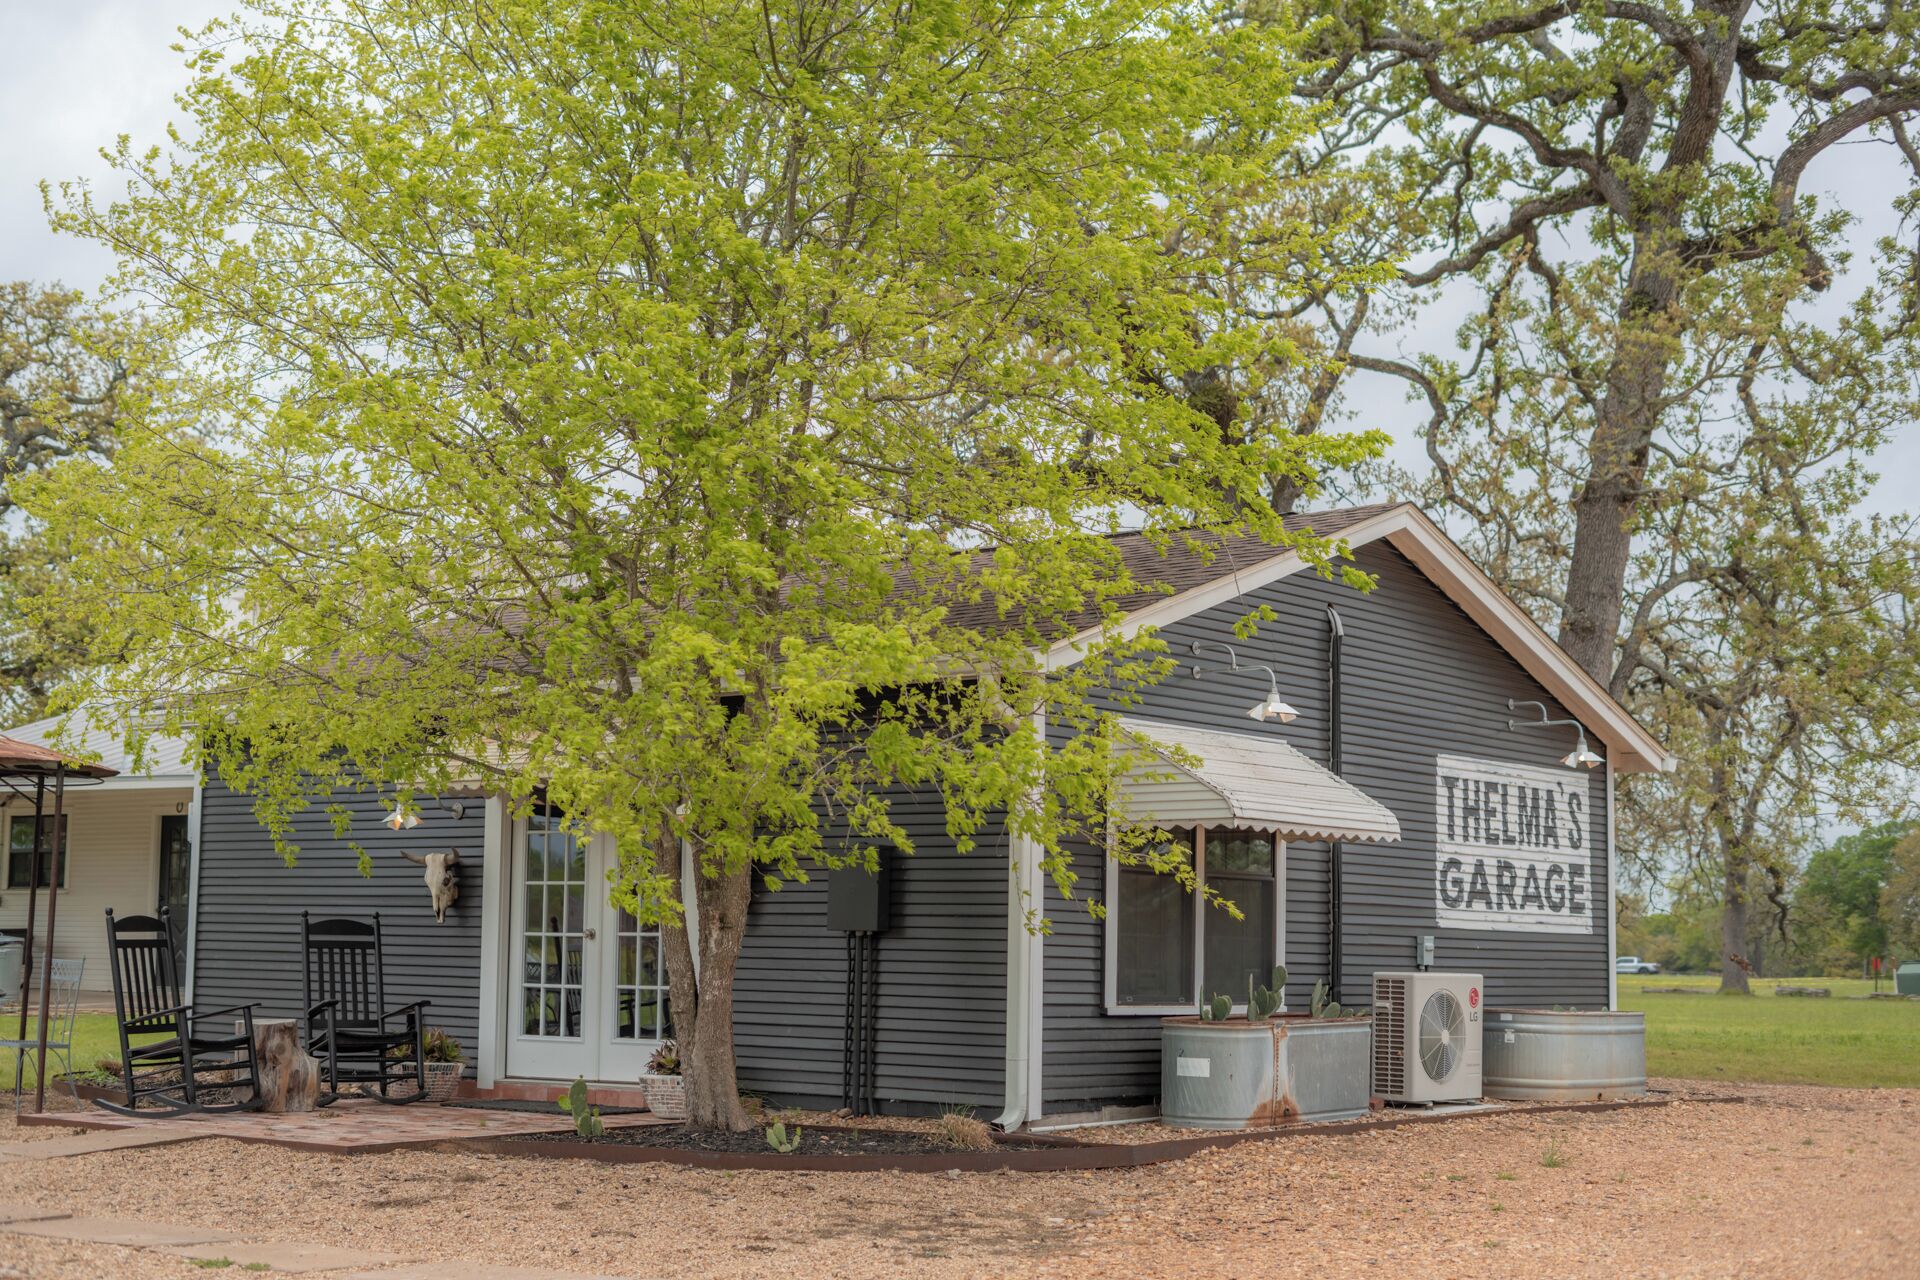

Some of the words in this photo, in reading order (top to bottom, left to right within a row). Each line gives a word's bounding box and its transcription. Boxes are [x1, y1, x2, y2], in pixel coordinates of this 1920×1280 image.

[1441, 776, 1583, 850] THELMA'S
[1439, 857, 1586, 915] GARAGE
[1469, 1011, 1479, 1022] LG
